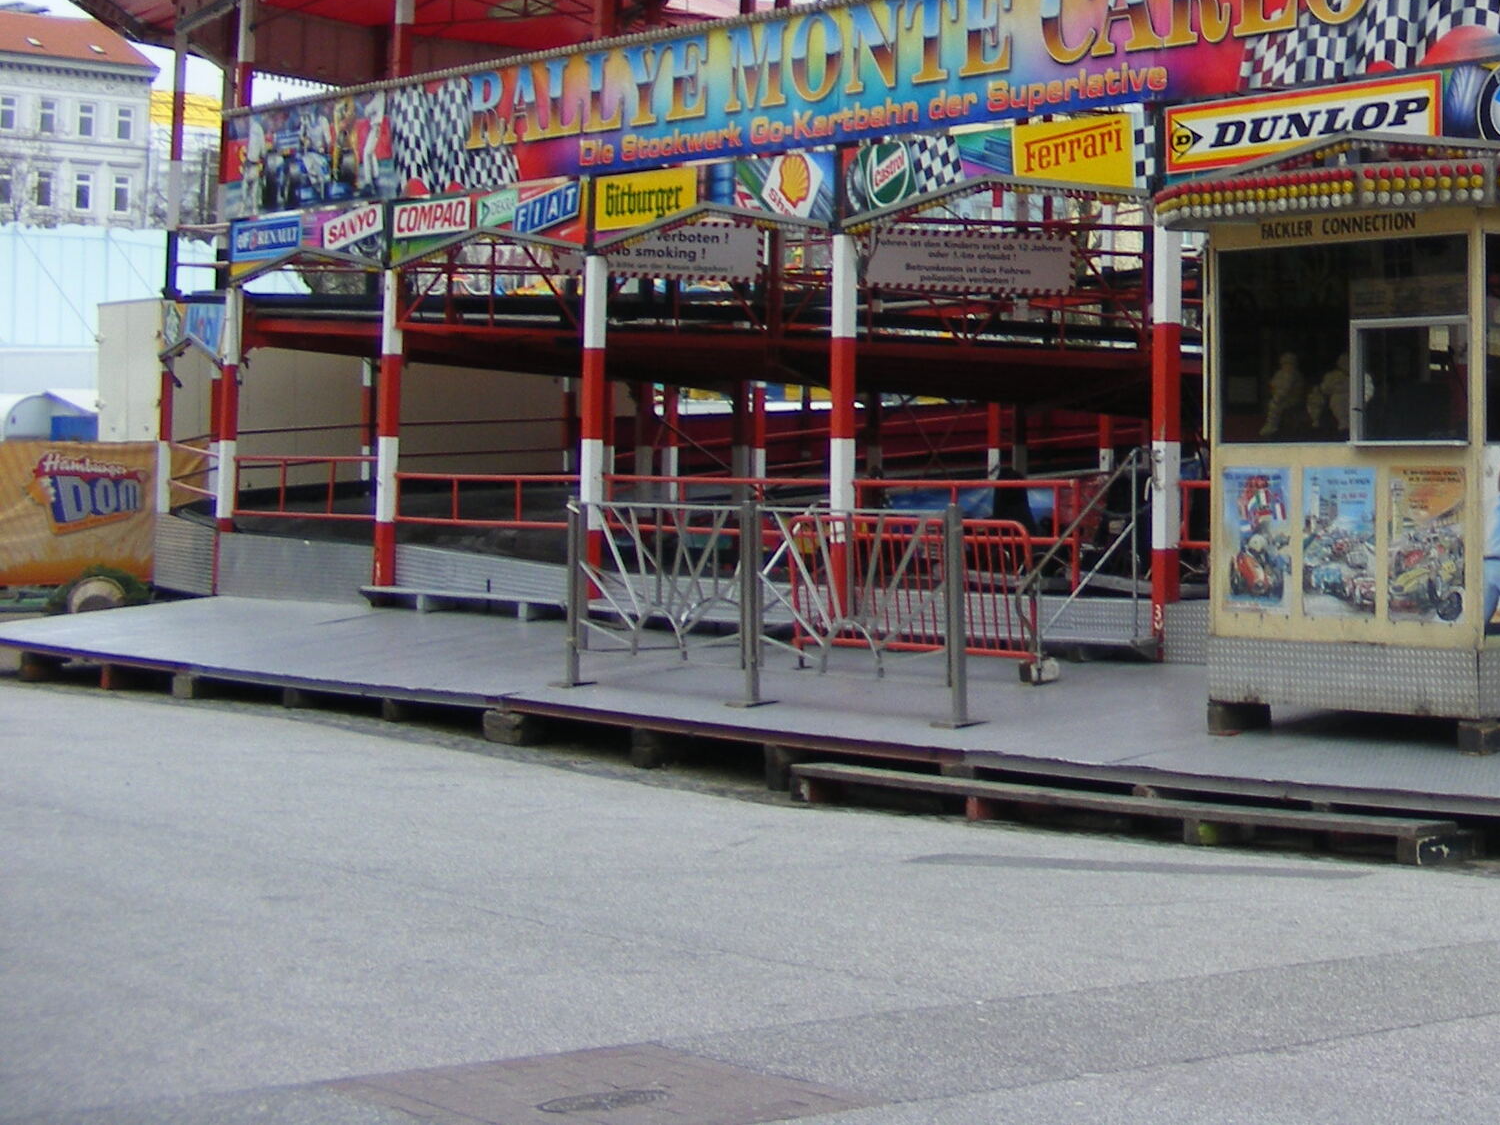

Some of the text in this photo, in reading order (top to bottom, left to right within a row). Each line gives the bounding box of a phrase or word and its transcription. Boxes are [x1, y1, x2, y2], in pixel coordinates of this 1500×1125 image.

[465, 36, 710, 149] RALLYE
[579, 62, 1168, 166] Die Stockwerk Go-Kartbahn der Superlative
[1209, 96, 1430, 149] DUNLOP
[1024, 120, 1122, 173] Ferrari
[873, 152, 905, 188] Castrol
[396, 199, 467, 233] COMPAQ
[517, 187, 577, 233] FIAT
[605, 182, 684, 219] Bitburger
[257, 225, 298, 246] RENAULT
[327, 208, 377, 245] SANYO
[1261, 212, 1417, 240] FACKLER CONNECTION
[635, 247, 697, 262] smoking
[42, 453, 127, 477] Hamburger
